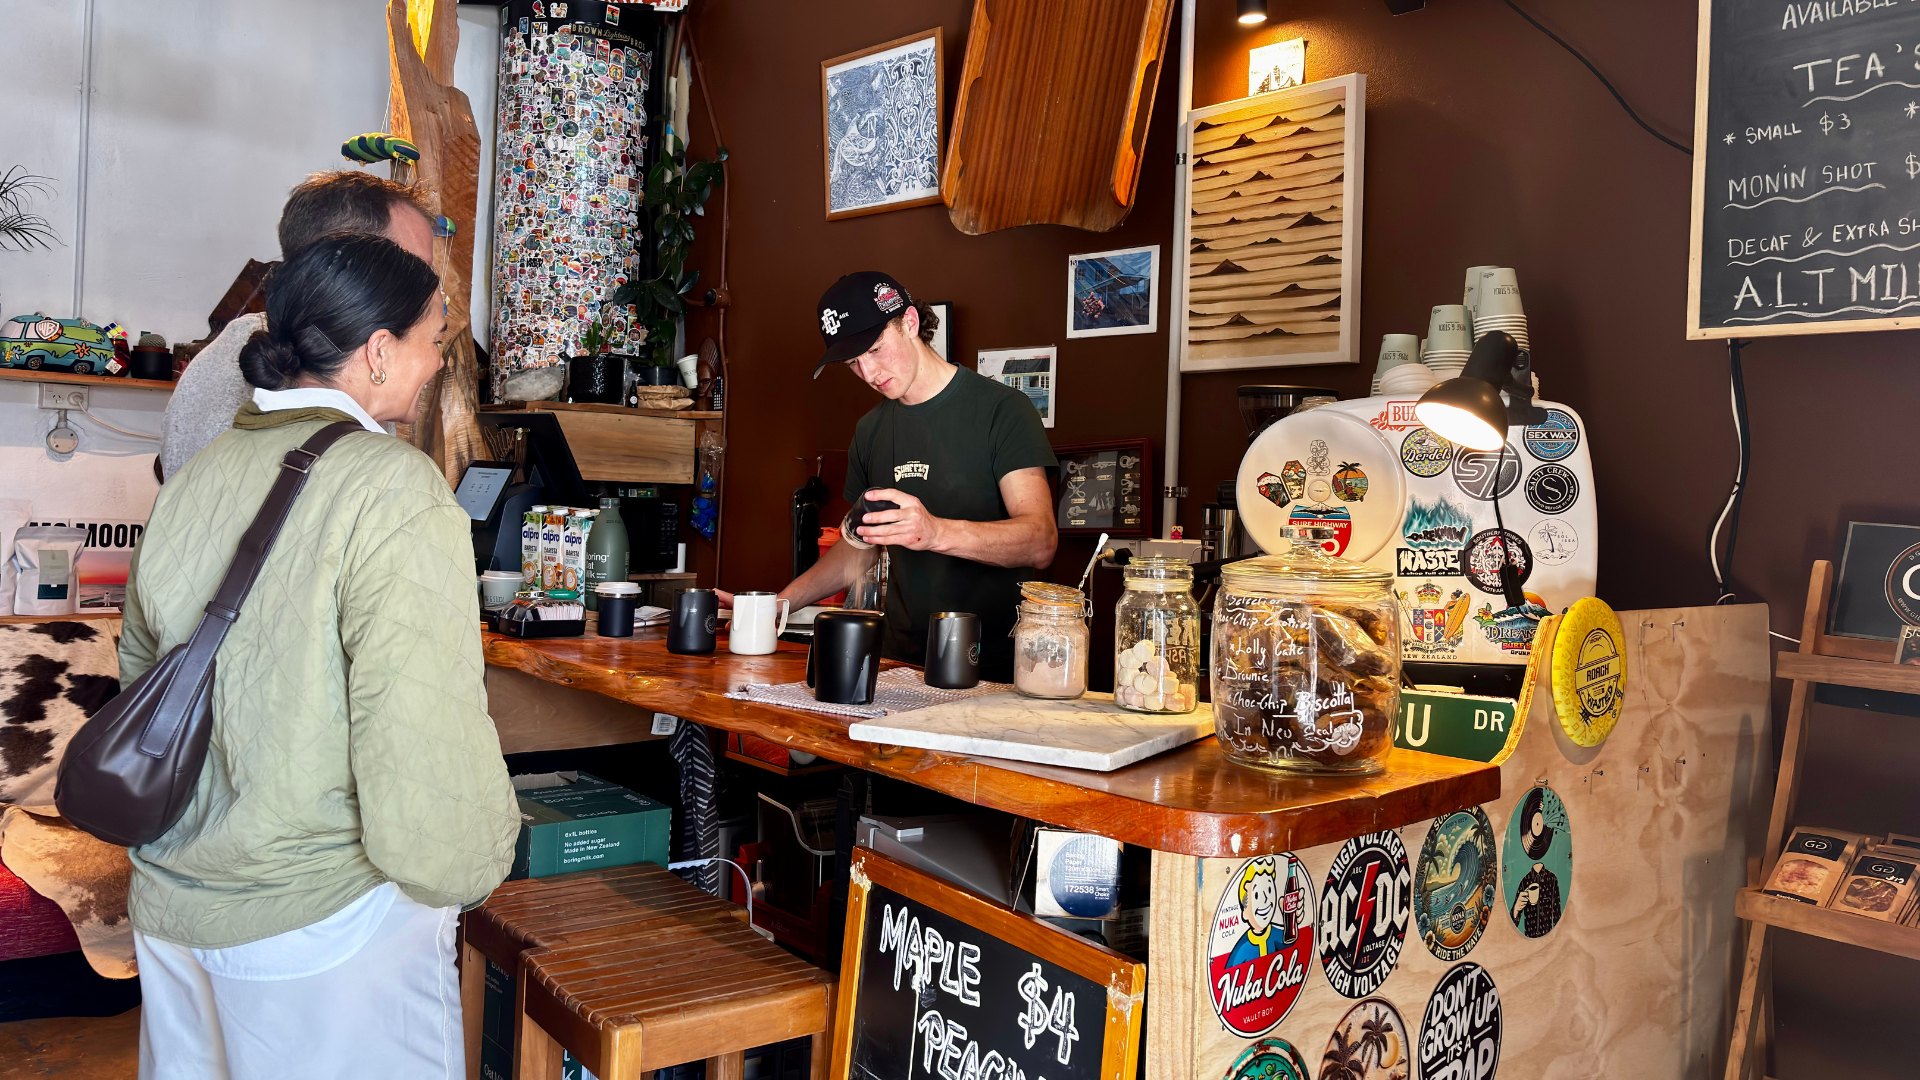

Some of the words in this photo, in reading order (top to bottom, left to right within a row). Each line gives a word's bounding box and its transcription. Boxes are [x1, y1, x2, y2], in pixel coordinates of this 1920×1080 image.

[1781, 0, 1898, 30] AVAILAB
[572, 23, 603, 36] BROWN
[1746, 122, 1801, 145] SMALL
[1820, 111, 1851, 136] $3
[1823, 162, 1878, 184] SHOT
[1728, 234, 1792, 258] DECAF
[1802, 226, 1823, 247] &
[1832, 220, 1889, 243] EXTRA
[1528, 431, 1548, 439] SEX
[1550, 431, 1572, 439] WAX
[1529, 470, 1545, 491] SALTY
[1547, 467, 1569, 479] CREW
[522, 527, 540, 541] alpro
[1314, 521, 1348, 529] HIGHWAY
[542, 529, 560, 544] alpro
[564, 532, 582, 547] alpro
[1504, 531, 1523, 544] TRIBES
[1398, 550, 1461, 573] WASTE
[1237, 637, 1266, 666] Lolly
[1502, 642, 1524, 650] SURF
[1586, 662, 1610, 682] ROACH
[1232, 691, 1288, 714] Choc-Chip
[1234, 713, 1251, 736] In
[1473, 709, 1505, 732] DR
[563, 847, 579, 855] Made
[599, 841, 620, 850] Zealand
[573, 838, 590, 847] added
[591, 837, 607, 846] sugar
[1330, 837, 1358, 882] HIGH
[1359, 829, 1405, 865] VOLTAGE
[1064, 885, 1095, 894] 172538
[1221, 904, 1239, 914] VINTAGE
[1219, 915, 1239, 931] NUKA
[1221, 929, 1236, 939] COLA
[1362, 939, 1386, 954] VOLTAGE
[1435, 945, 1451, 960] RIDE
[1452, 947, 1466, 960] THE
[1465, 927, 1482, 952] WAVE
[1325, 957, 1352, 996] HIGH
[1353, 936, 1403, 998] VOLTAGE
[880, 904, 981, 1007] MAPLE
[1018, 962, 1080, 1065] $4
[1217, 963, 1263, 1016] Nuka
[1265, 950, 1304, 998] Cola
[1431, 966, 1484, 1027] DON'T
[1243, 1011, 1261, 1024] VAULT
[1261, 1006, 1274, 1018] BOY
[1422, 1001, 1474, 1063] GROW
[1475, 988, 1499, 1028] UP
[1447, 1042, 1463, 1063] IT'S
[1464, 1037, 1471, 1051] A
